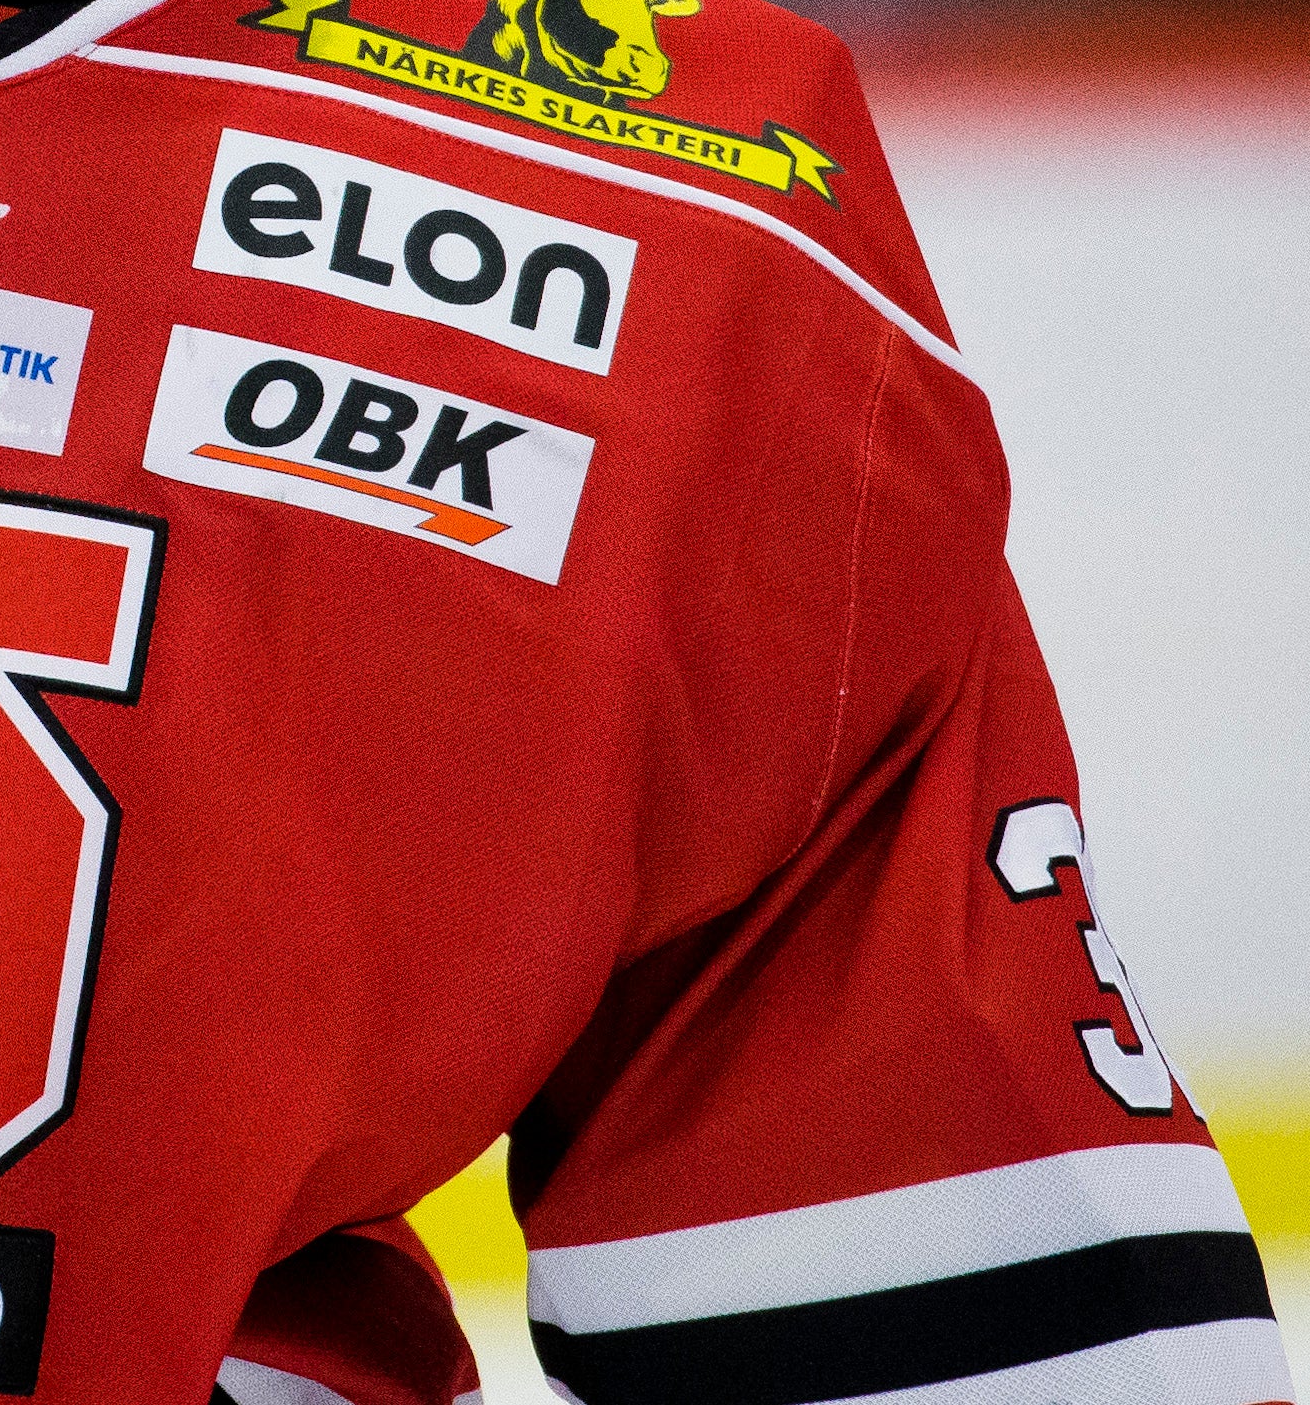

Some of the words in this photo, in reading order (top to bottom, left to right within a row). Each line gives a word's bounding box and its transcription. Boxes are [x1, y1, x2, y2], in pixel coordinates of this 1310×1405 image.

[355, 36, 527, 110] NÄRKES
[541, 96, 742, 168] SLAKTERI
[223, 359, 529, 512] OBK
[985, 796, 1209, 1124] 3
